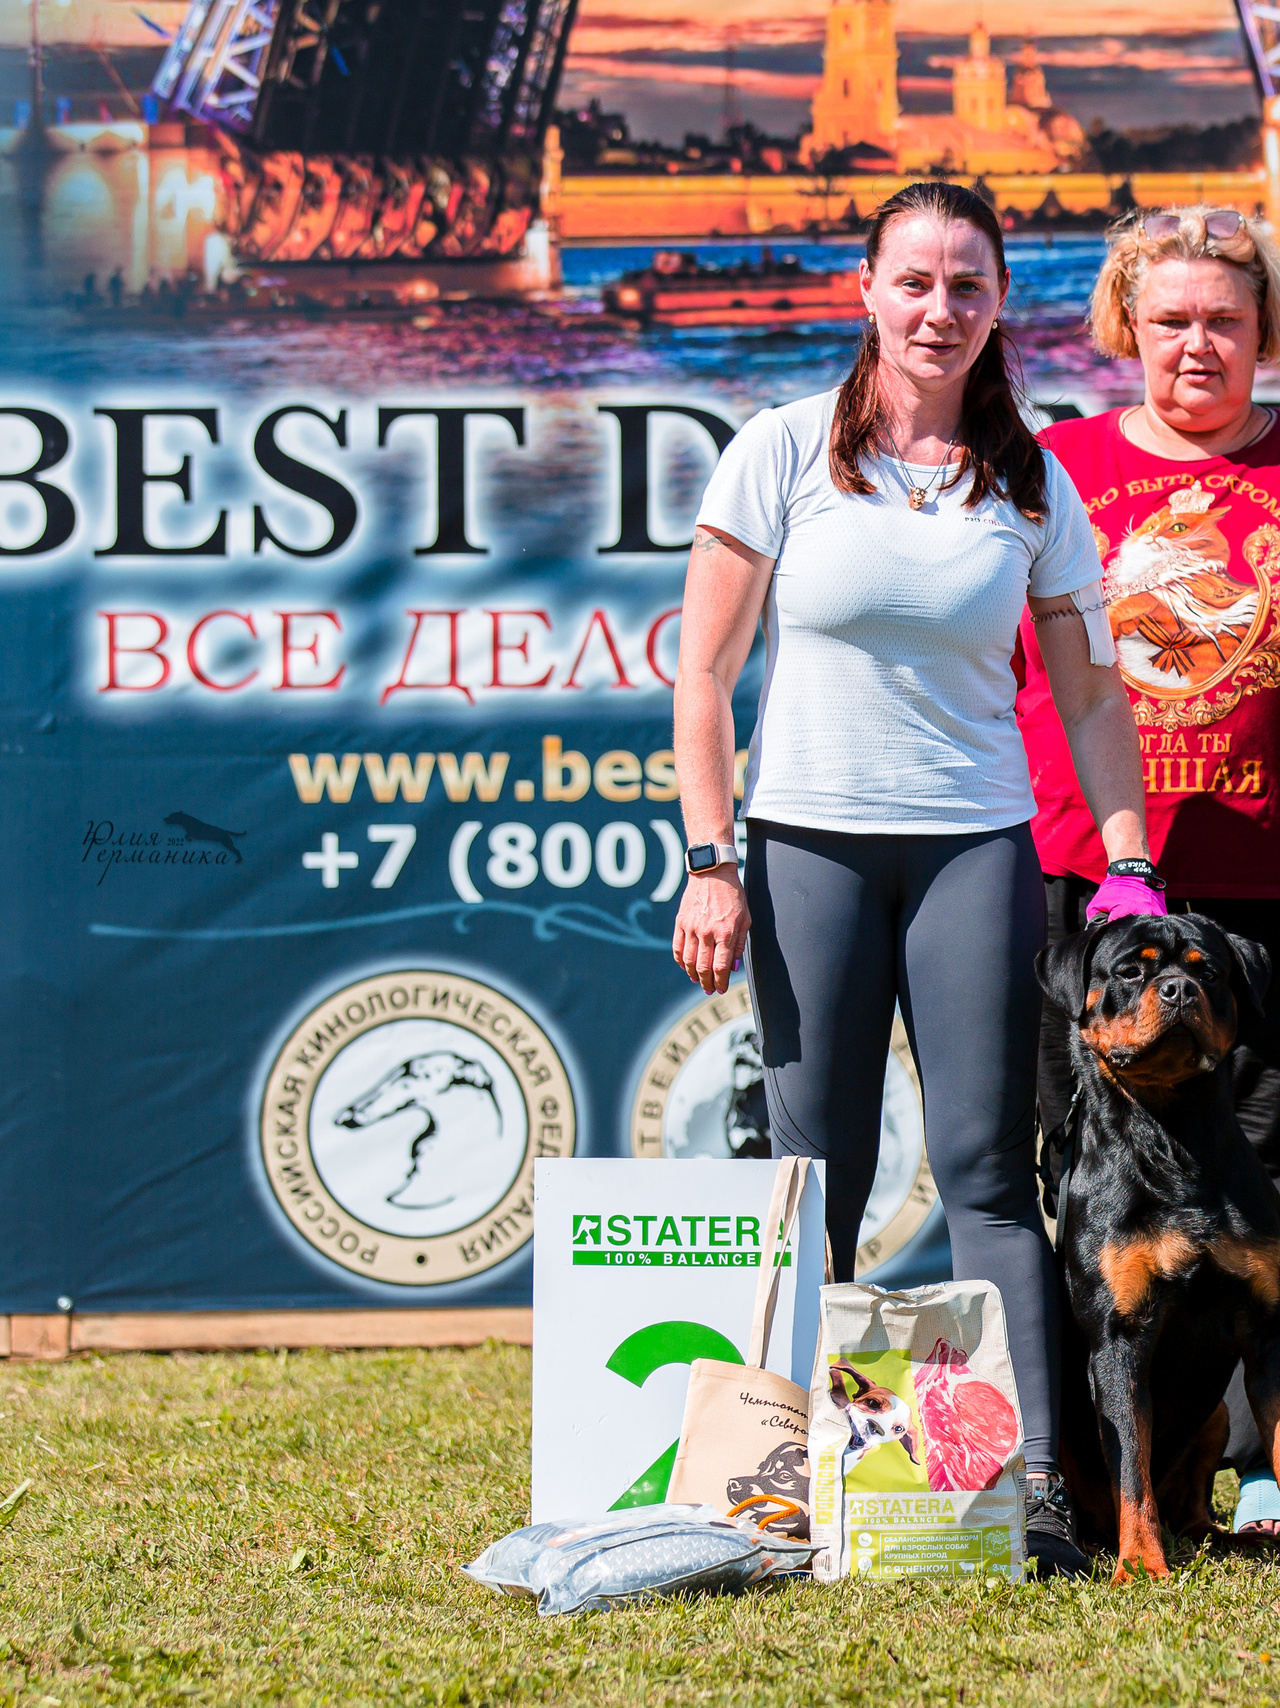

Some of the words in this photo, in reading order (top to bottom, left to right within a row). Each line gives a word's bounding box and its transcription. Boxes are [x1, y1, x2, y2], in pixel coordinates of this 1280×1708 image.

[1125, 472, 1196, 498] БЫТЬ
[97, 608, 348, 693] ВСЕ
[1197, 732, 1233, 754] ТЫ
[288, 736, 681, 803] www.bes
[303, 823, 417, 890] +7
[446, 818, 684, 904] (800)
[296, 984, 552, 1087] КИНОЛОГИЧЕСКАЯ
[276, 1075, 380, 1265] РОССИЙСКАЯ
[458, 1095, 563, 1265] ФЕДАЦИЯ
[603, 1252, 652, 1265] 100%
[662, 1252, 757, 1266] BALANCE
[866, 1498, 955, 1515] STATERA
[893, 1516, 939, 1524] BALANCE
[883, 1534, 959, 1544] СБАЛАНСИРОВАННЫЙ
[959, 1534, 979, 1542] КОРМ
[883, 1544, 901, 1552] ДЛЯ
[901, 1543, 944, 1551] ВЗРОСЛЫХ
[883, 1552, 920, 1560] КРУПНЫХ
[921, 1552, 948, 1560] ПОРОД
[893, 1564, 949, 1574] ЯГНЕНКОМ
